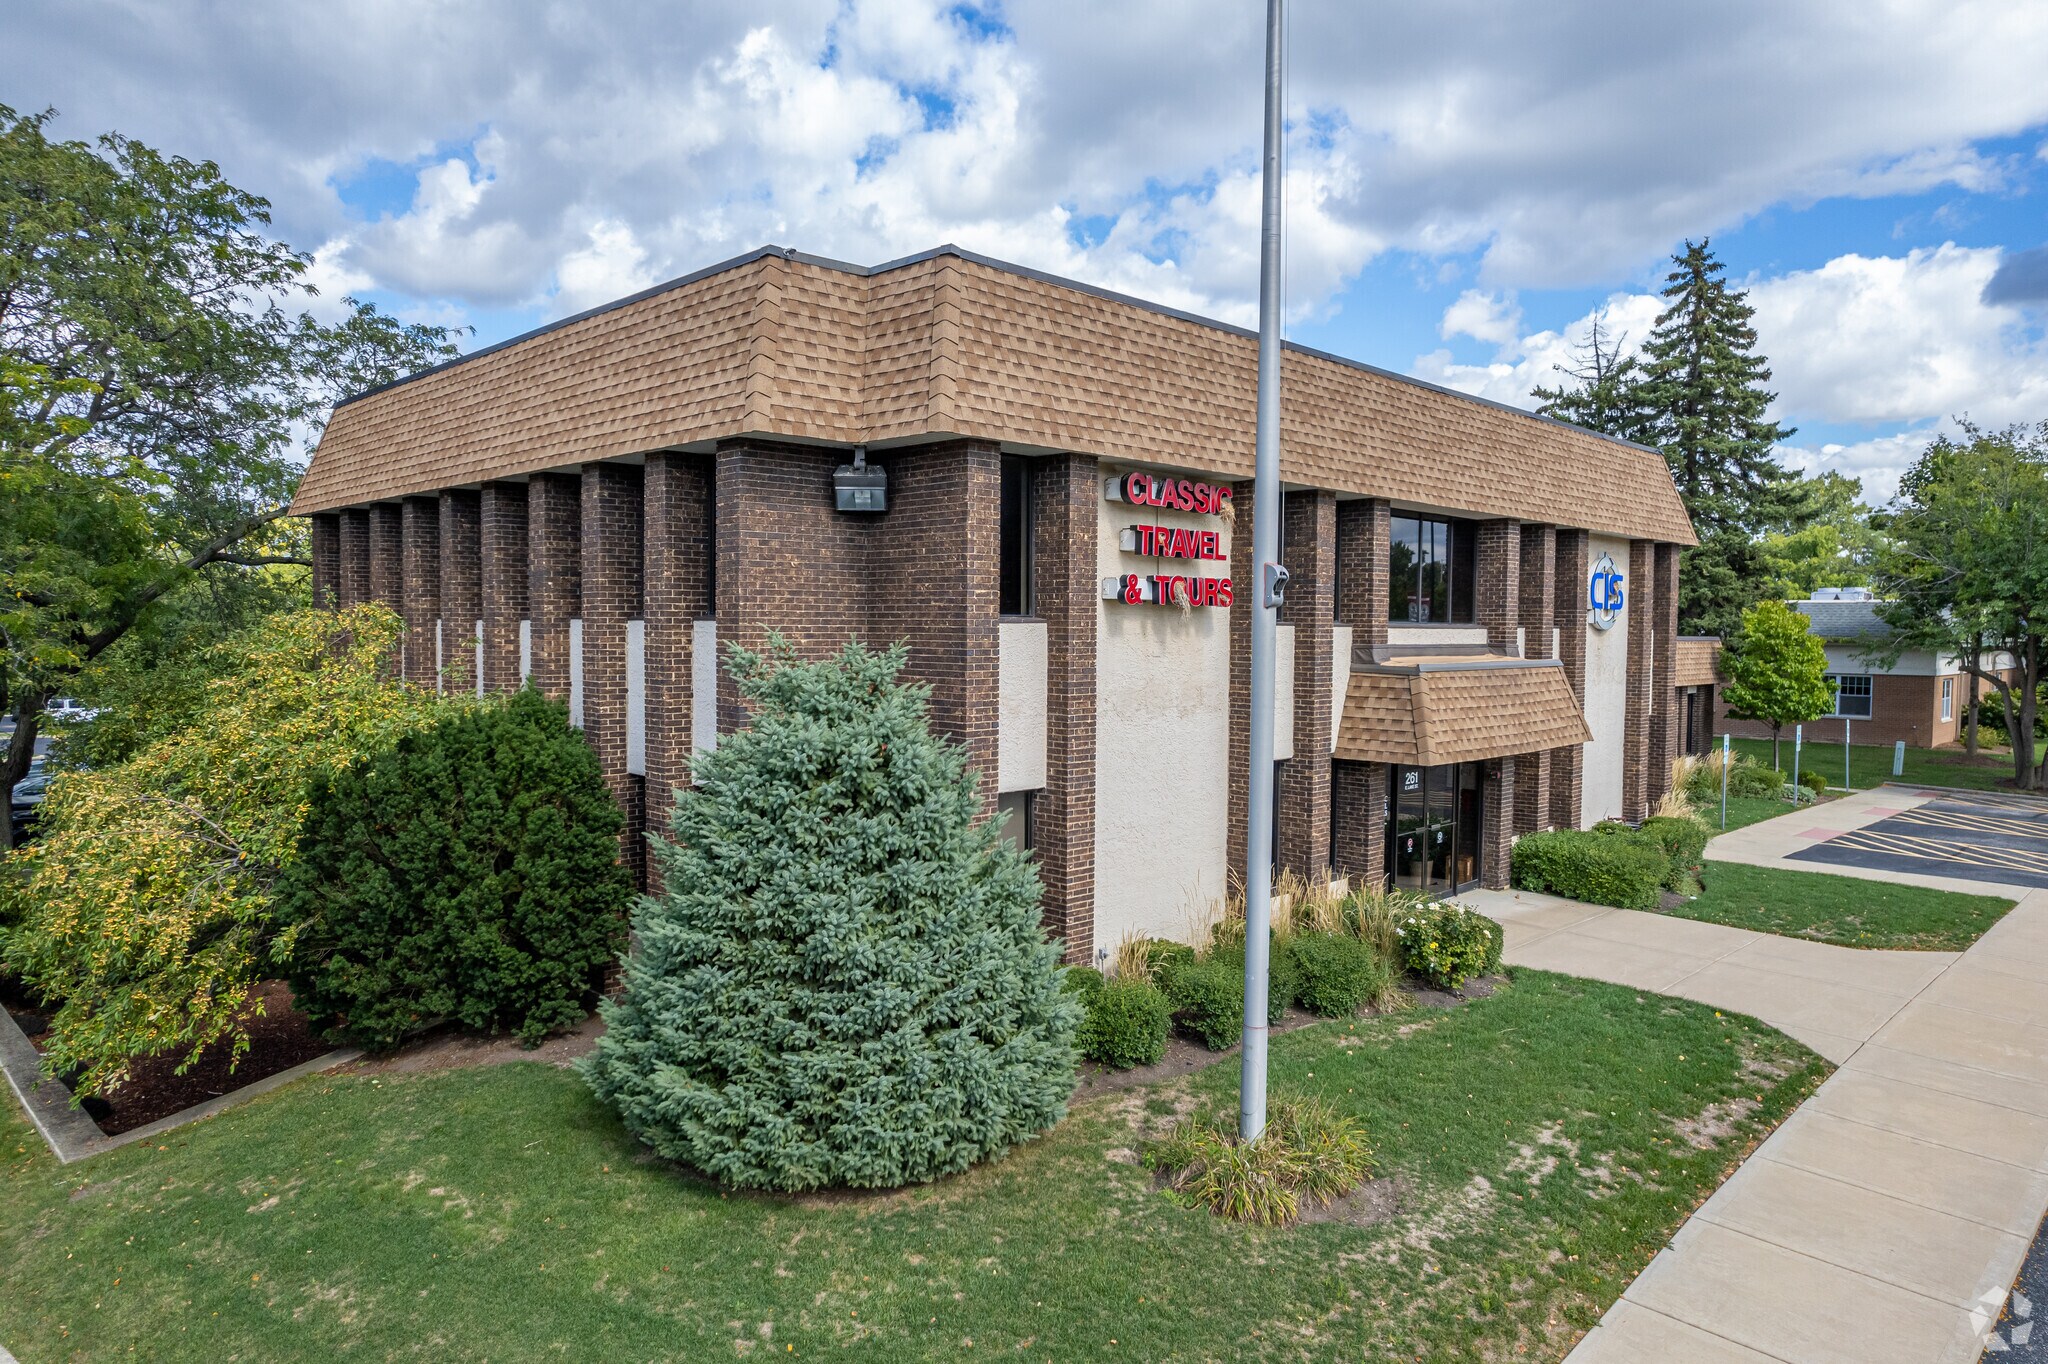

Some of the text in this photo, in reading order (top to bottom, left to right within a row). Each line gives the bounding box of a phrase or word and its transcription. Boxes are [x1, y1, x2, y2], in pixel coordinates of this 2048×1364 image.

[1127, 472, 1233, 514] CLASSIC
[1137, 524, 1227, 561] TRAVEL
[1125, 573, 1234, 607] & TOURS
[1590, 572, 1624, 610] CIS
[1405, 771, 1418, 785] 261
